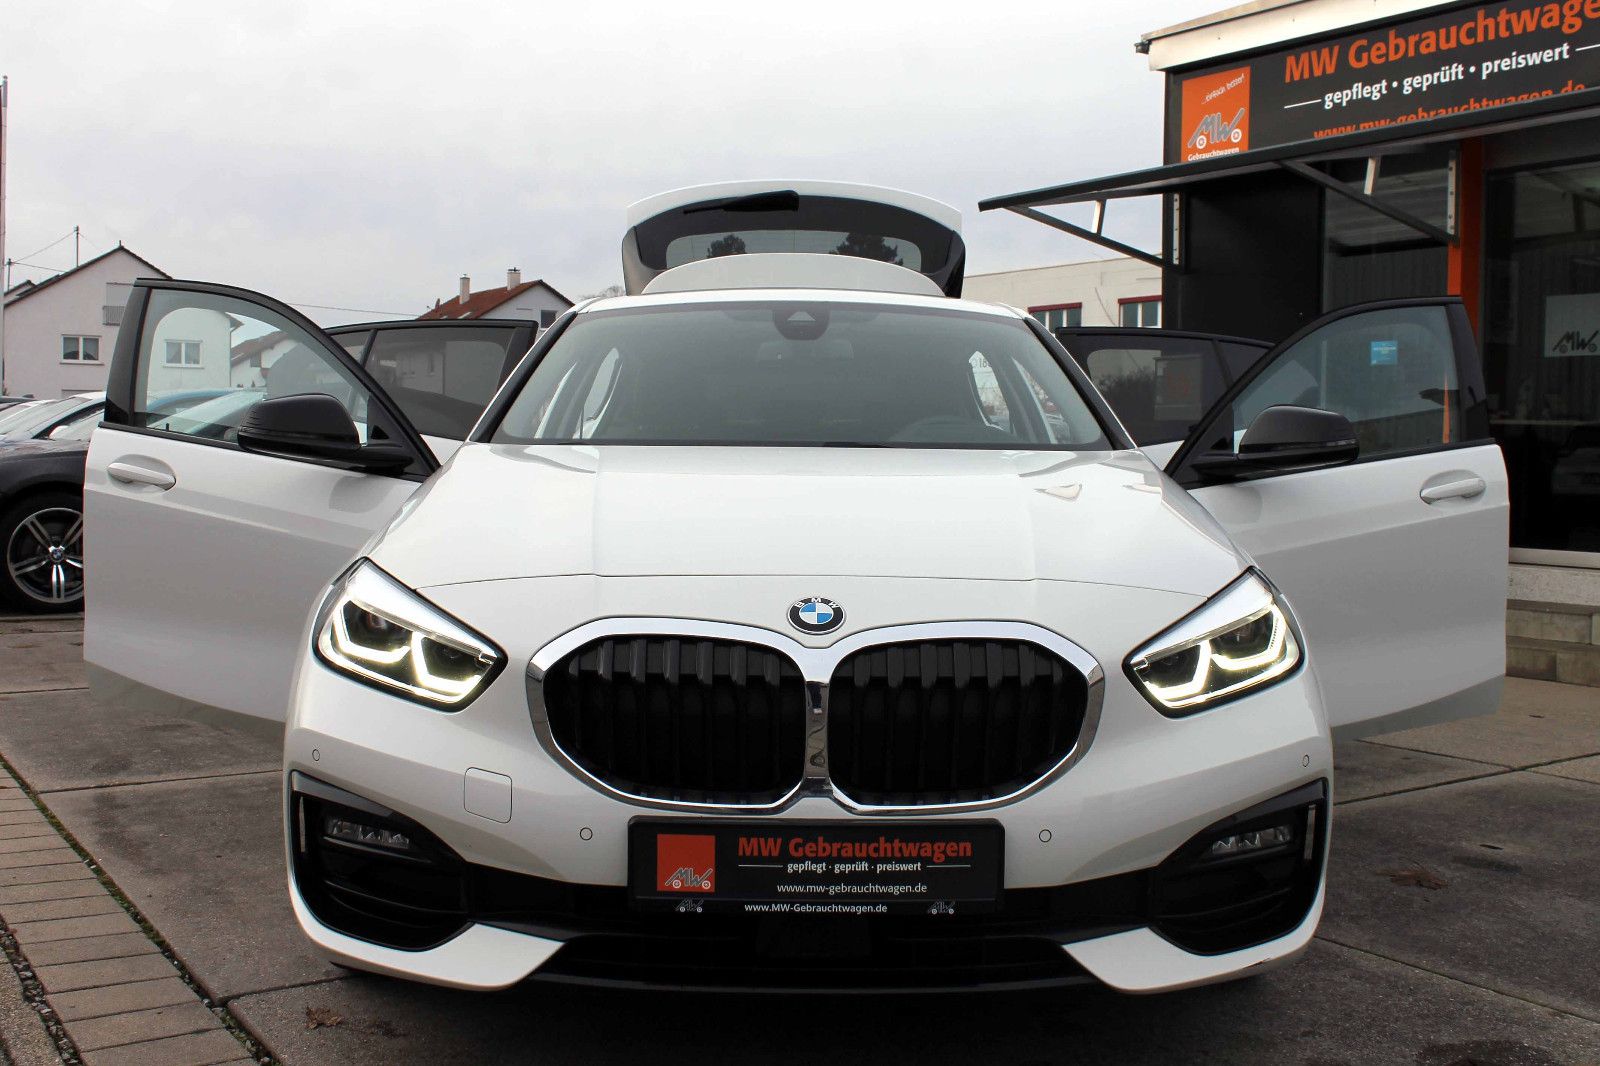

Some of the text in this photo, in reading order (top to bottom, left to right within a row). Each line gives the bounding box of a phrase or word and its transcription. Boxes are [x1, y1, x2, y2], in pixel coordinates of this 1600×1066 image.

[1285, 44, 1340, 84] MW
[1324, 42, 1570, 110] gepflegt geprüft preiswert
[793, 596, 841, 609] BMW
[738, 836, 973, 863] MW Gebrauchtwagen
[787, 860, 922, 874] gepflegt geprüft preiswert
[776, 882, 928, 896] www.mw-gebrauchtwagen.de
[744, 903, 888, 915] www.MW-Gebrauchtwagen.de
